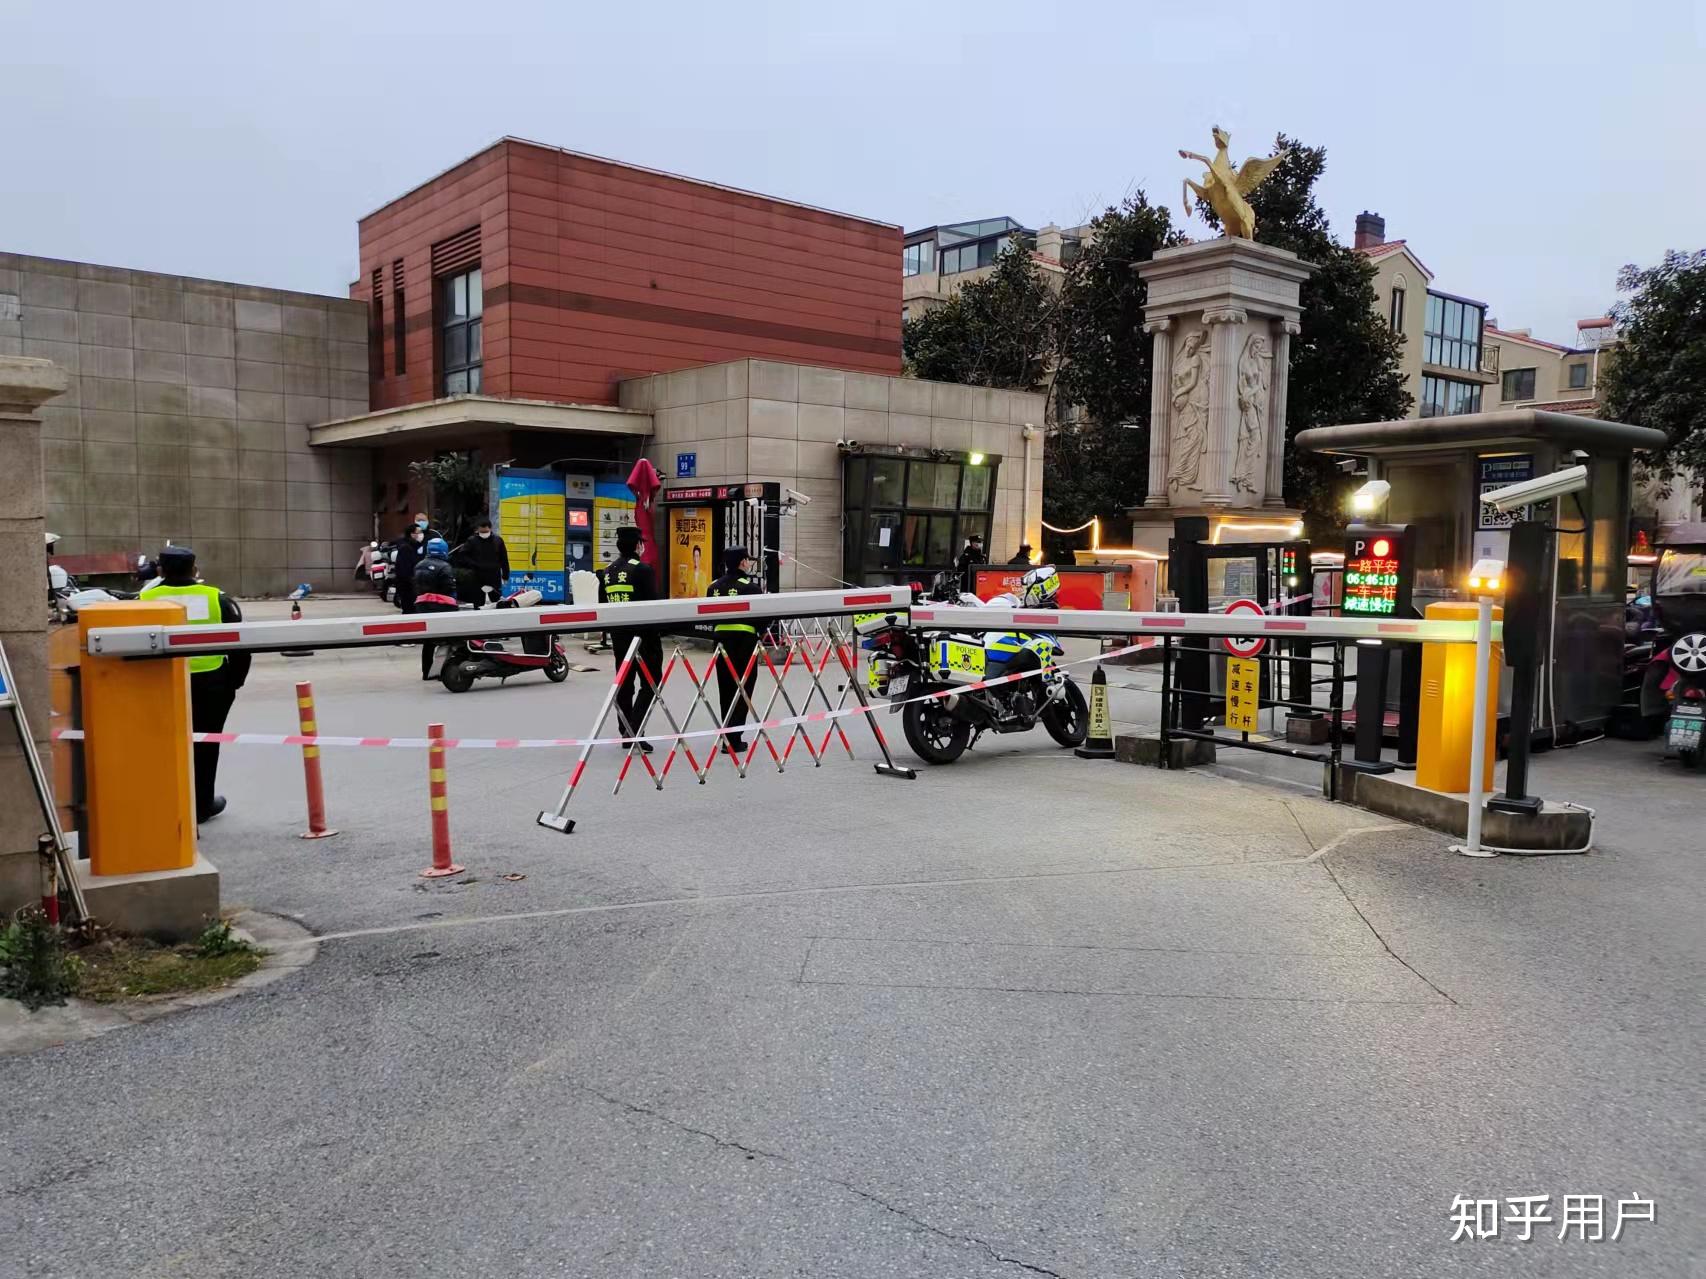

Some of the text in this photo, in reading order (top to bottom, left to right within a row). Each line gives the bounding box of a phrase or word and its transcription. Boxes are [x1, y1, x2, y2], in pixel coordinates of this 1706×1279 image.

[675, 519, 706, 532] 美团买药
[1354, 540, 1366, 556] P
[1347, 559, 1398, 574] 一路平安
[547, 580, 557, 593] 5
[1346, 573, 1398, 586] 06:46:10
[1346, 585, 1397, 601] 一车一杆
[1344, 597, 1396, 613] 减速慢行
[956, 645, 977, 656] POLICE
[1230, 663, 1241, 726] 减速慢行
[1242, 668, 1255, 728] 一车一杆
